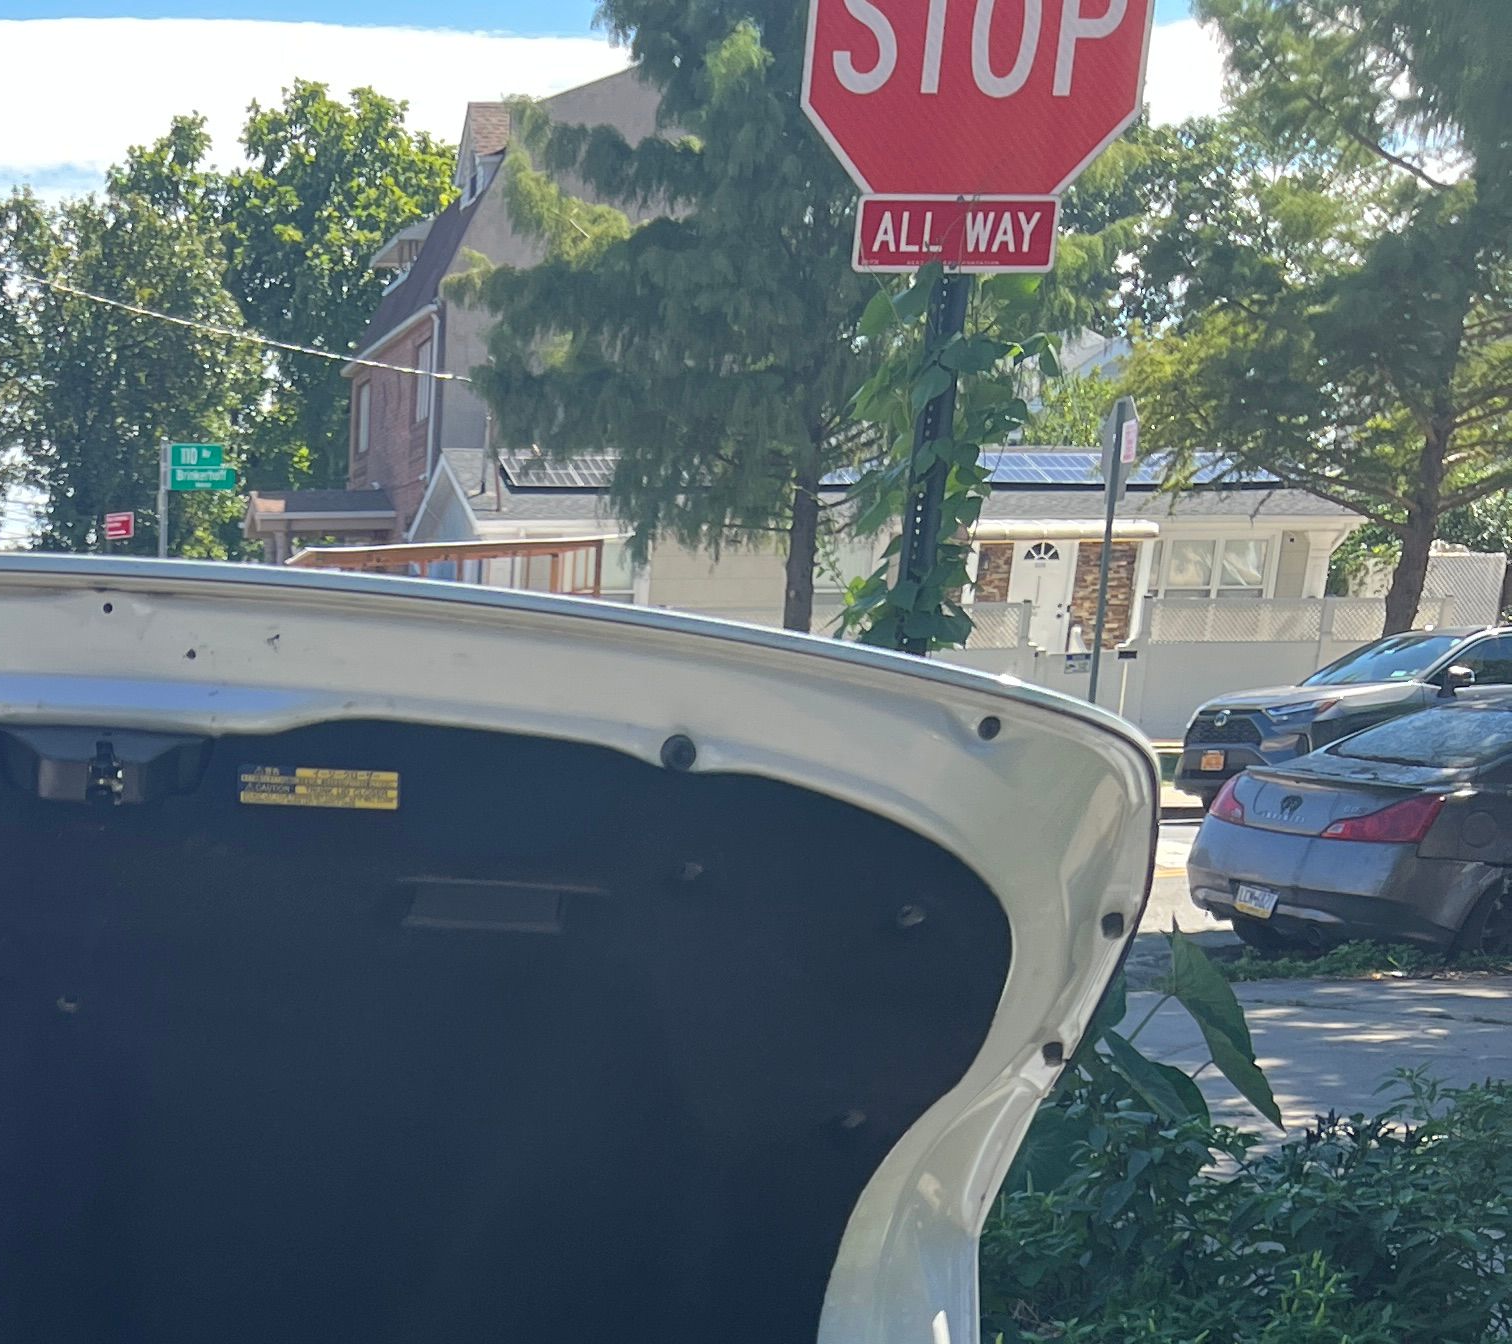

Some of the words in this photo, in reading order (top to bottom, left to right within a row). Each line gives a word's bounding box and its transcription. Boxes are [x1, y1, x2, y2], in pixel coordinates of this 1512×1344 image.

[871, 211, 943, 253] ALL
[965, 211, 1042, 253] WAY
[255, 782, 291, 793] CAUTION
